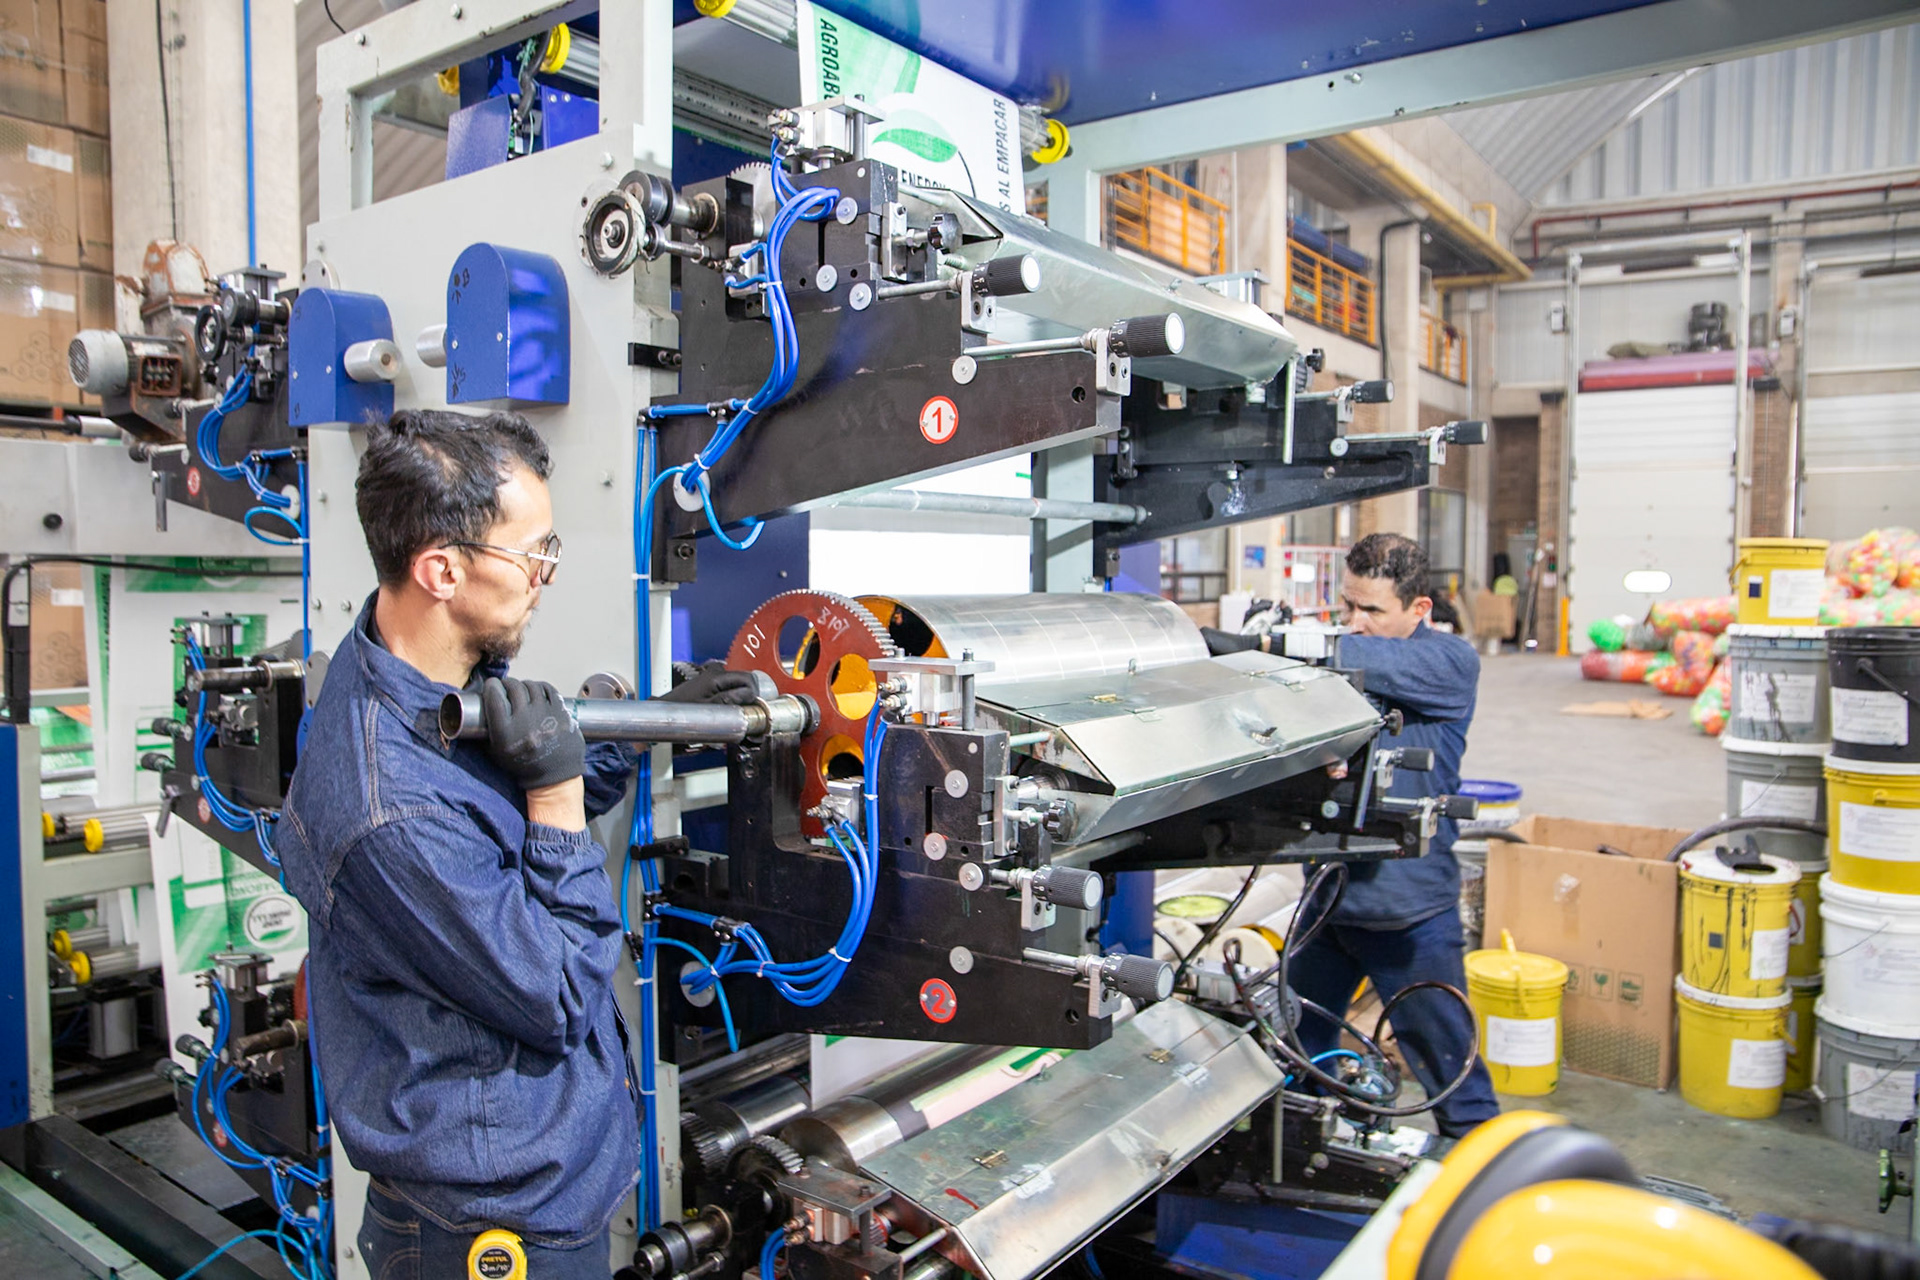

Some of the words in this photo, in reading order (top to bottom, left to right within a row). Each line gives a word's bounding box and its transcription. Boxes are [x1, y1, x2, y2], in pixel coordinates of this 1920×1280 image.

[992, 98, 1010, 175] EMPACAR
[998, 180, 1011, 199] AL
[932, 406, 942, 433] 1
[742, 623, 766, 658] 101
[931, 988, 947, 1014] 2
